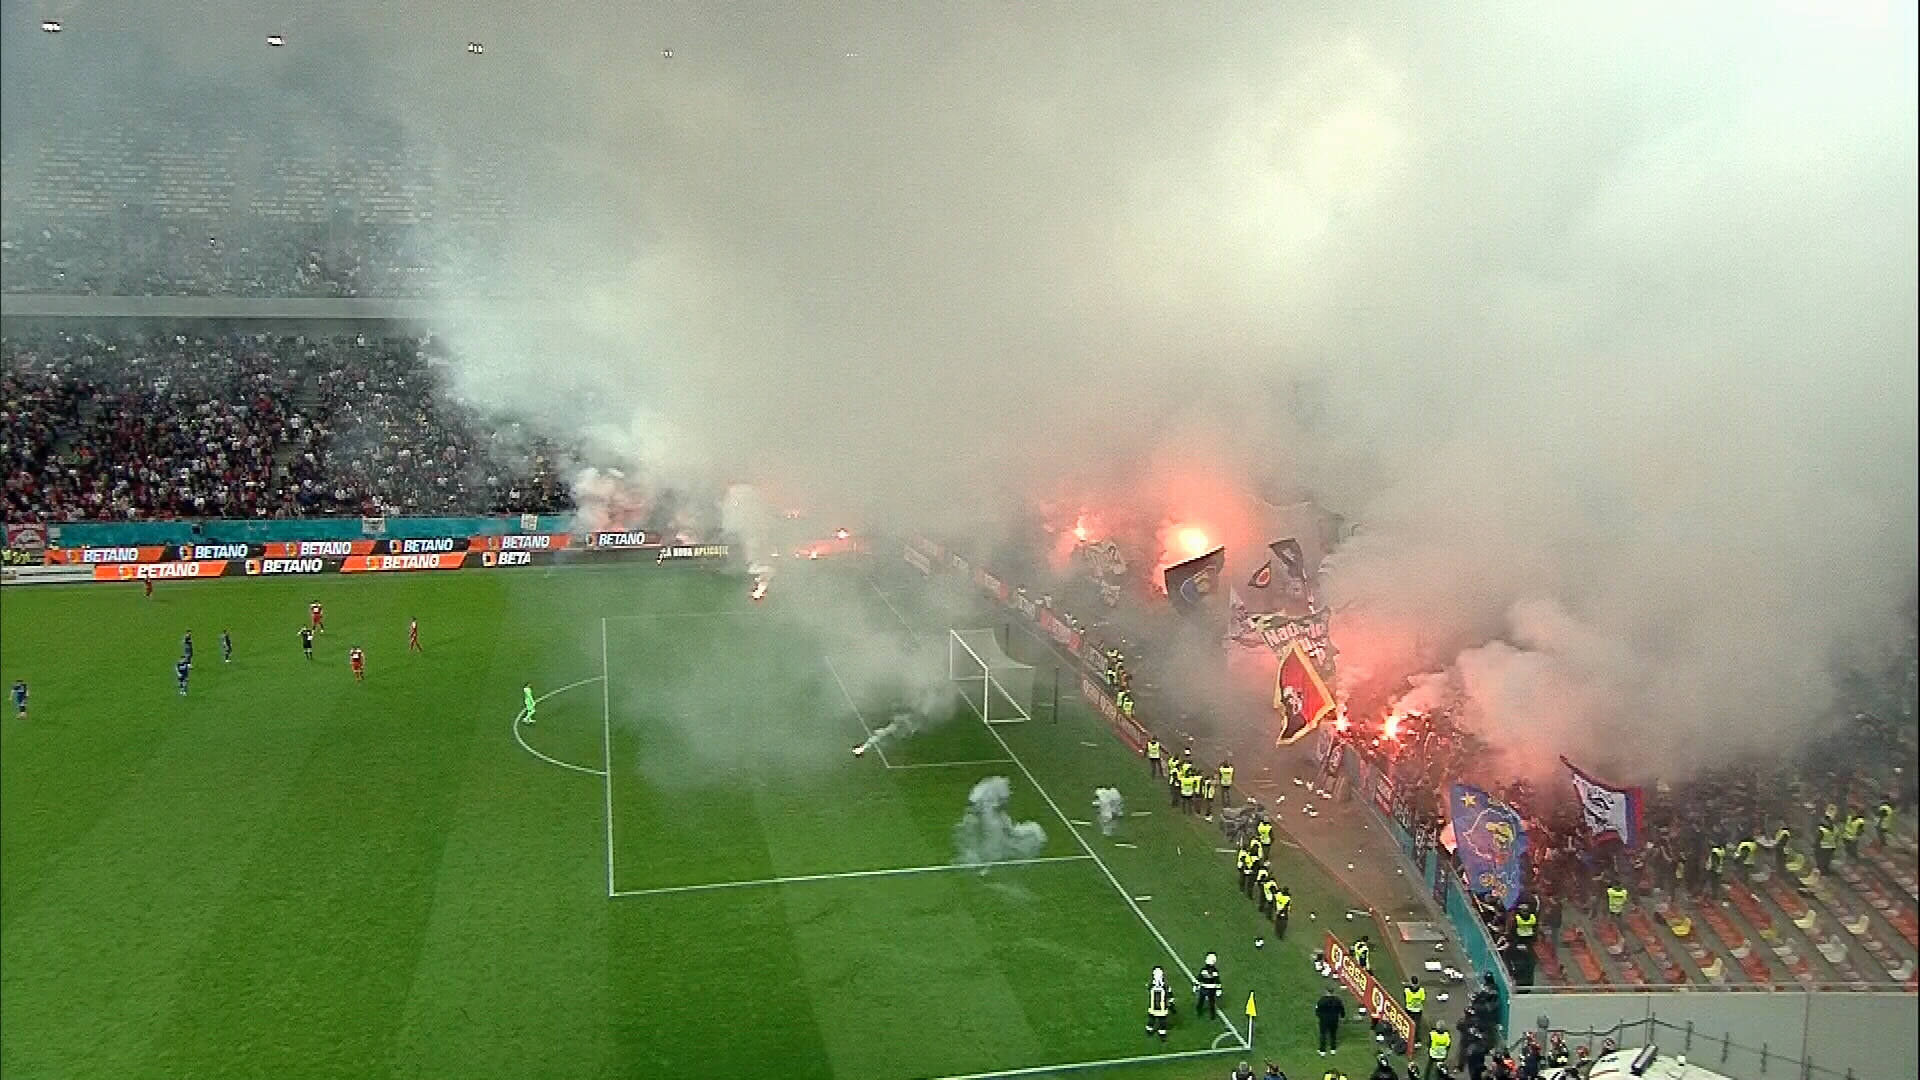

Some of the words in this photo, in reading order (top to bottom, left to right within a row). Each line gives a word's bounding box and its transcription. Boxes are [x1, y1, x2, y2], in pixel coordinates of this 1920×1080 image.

[301, 541, 351, 555] BETANO
[404, 539, 453, 553] BETANO
[502, 535, 550, 549] BETANO
[83, 547, 138, 563] BETANO
[195, 544, 248, 559] BETANO
[498, 551, 531, 565] BETA
[263, 558, 323, 573] BETANO
[383, 554, 440, 568] BETANO
[137, 561, 199, 578] BETANO
[1343, 955, 1367, 991] casa
[1384, 999, 1410, 1039] casa
